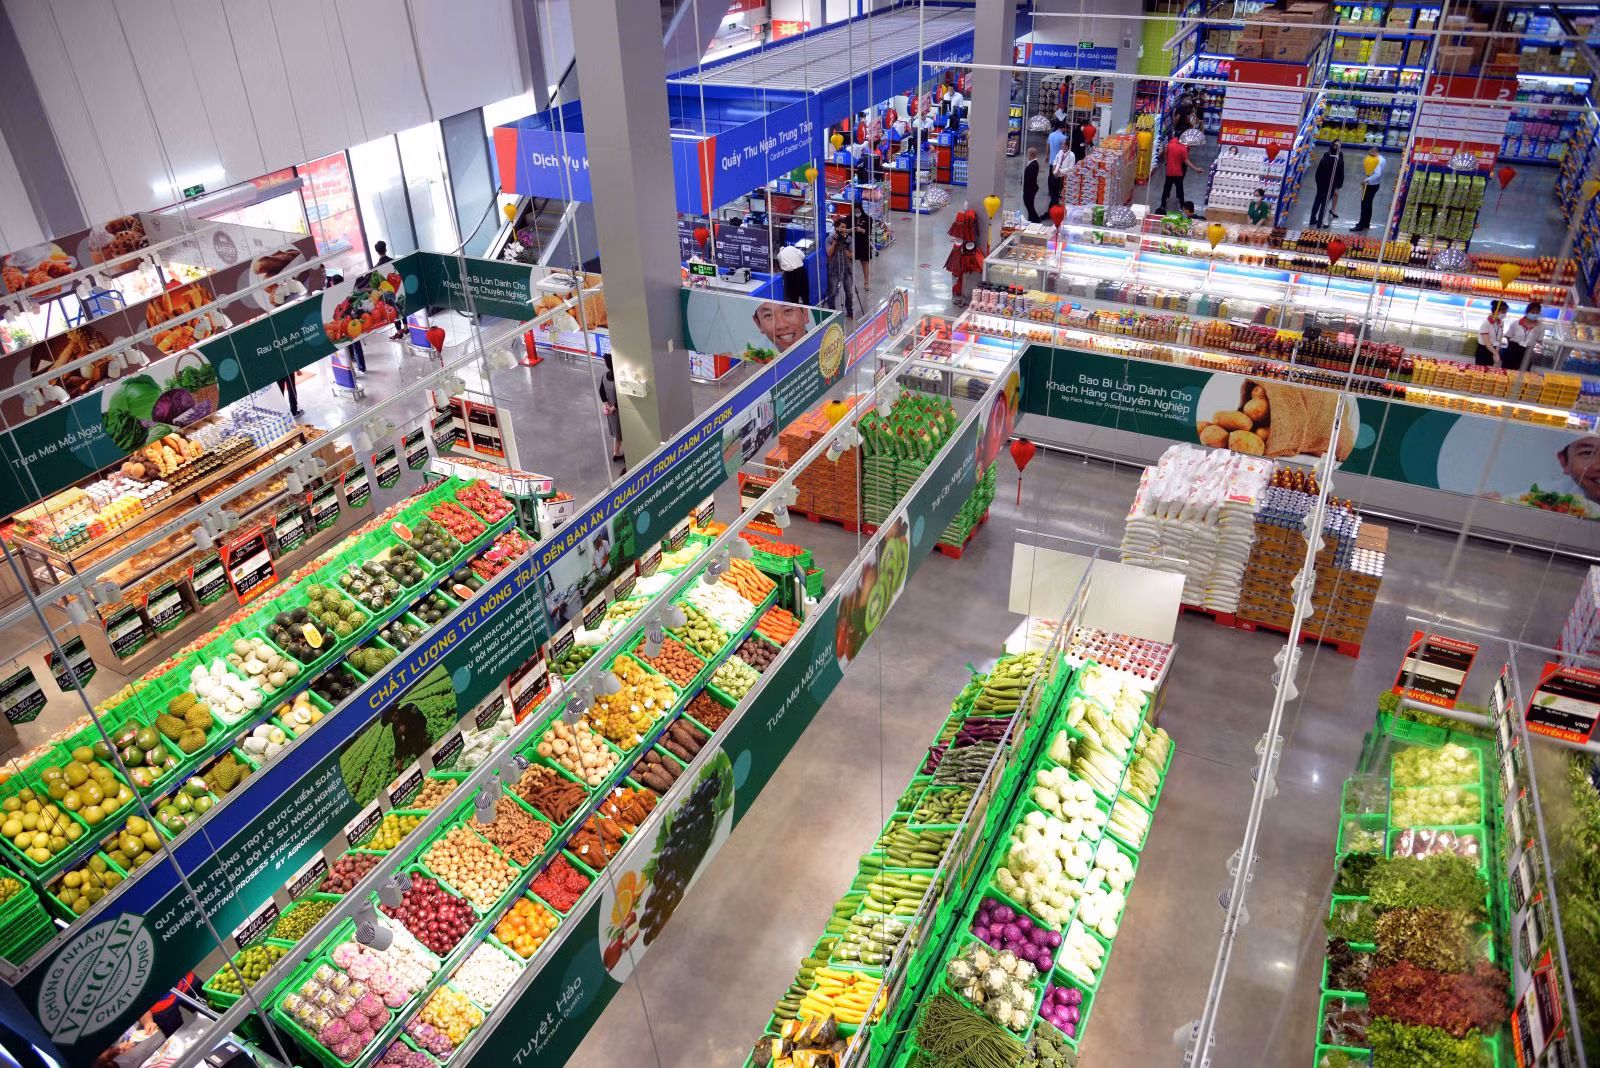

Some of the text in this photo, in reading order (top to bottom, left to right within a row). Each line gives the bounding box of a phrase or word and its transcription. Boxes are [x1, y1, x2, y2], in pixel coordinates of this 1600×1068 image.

[1234, 69, 1302, 86] 1 1
[1431, 84, 1510, 102] 2 2
[533, 153, 558, 169] Dịch
[563, 156, 579, 172] Vụ
[745, 145, 758, 160] Thu
[780, 129, 797, 144] Trung
[513, 281, 526, 290] Cho
[257, 344, 272, 356] Rau
[289, 332, 301, 341] An
[1047, 381, 1188, 414] Khách Hàng Chuyên Nghiệp
[1080, 374, 1099, 386] Bao
[1116, 380, 1136, 392] Lớn
[1140, 384, 1166, 397] Dành
[1171, 390, 1192, 401] Cho
[370, 670, 405, 708] CHẤT
[411, 630, 456, 674] LƯỢNG
[460, 612, 477, 632] TỪ
[480, 585, 512, 616] NÔNG
[544, 542, 565, 565] ĐẾN
[567, 526, 588, 547] BÀN
[590, 512, 603, 527] ĂN
[614, 471, 651, 507] QUALITY
[654, 451, 676, 477] FROM
[679, 433, 701, 456] FARM
[702, 423, 712, 437] TO
[714, 406, 733, 426] FORK
[470, 640, 483, 654] THU
[484, 622, 505, 643] HOẠCH
[504, 611, 515, 624] VÀ
[501, 619, 523, 641] CHUYÊN
[478, 644, 508, 674] HARVESTING
[509, 633, 520, 646] AND
[499, 636, 532, 666] PROFESSIONAL
[236, 860, 268, 892] PROSESS
[270, 828, 301, 860] STRICTLY
[304, 789, 345, 830] CONTROLLED
[247, 852, 262, 867] ĐỘI
[262, 837, 275, 852] KỸ
[276, 825, 289, 839] SƯ
[291, 805, 313, 826] NÔNG
[315, 778, 341, 805] NGHIỆP
[275, 799, 350, 870] BY TEAM
[155, 765, 337, 930] QUY TRNH TRỒNG TRỌT ĐƯỢC KIỂM SOÁT
[59, 920, 133, 1035] VietGAP
[513, 978, 581, 1064] Tuyệt Hảo
[537, 990, 584, 1054] Premium Quality
